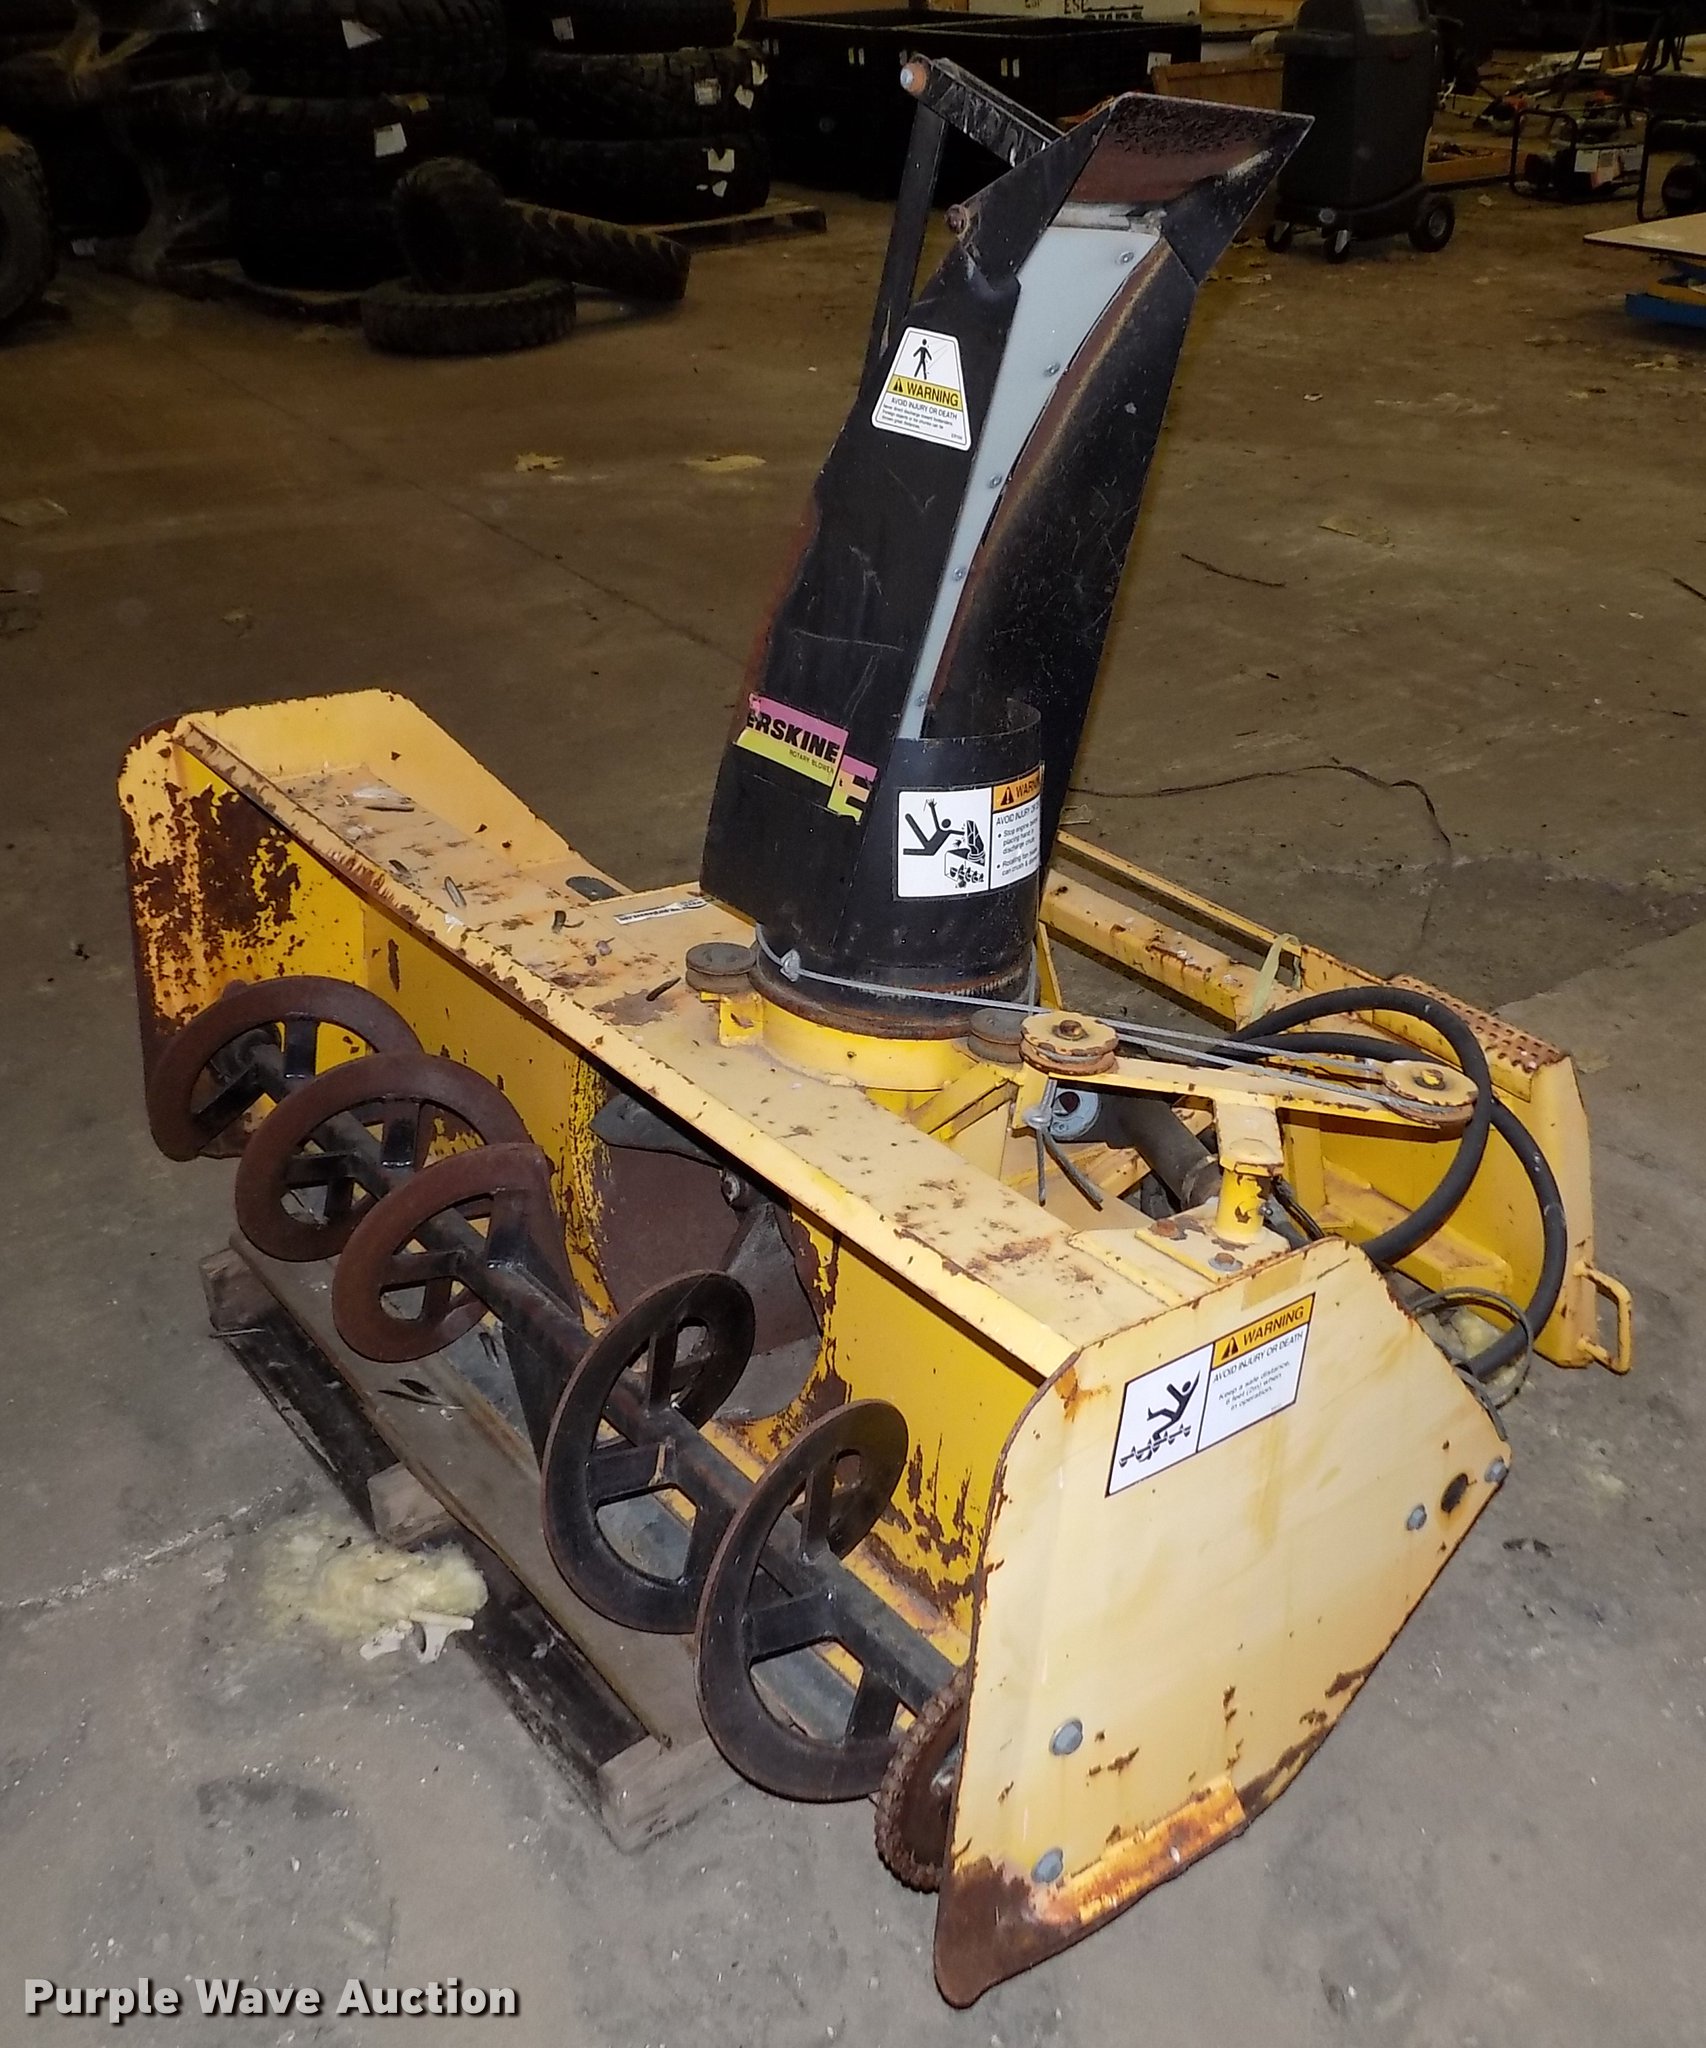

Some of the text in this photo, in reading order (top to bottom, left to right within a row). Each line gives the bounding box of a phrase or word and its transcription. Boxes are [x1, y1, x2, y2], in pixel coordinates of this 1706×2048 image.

[891, 397, 958, 420] AVOID INJURY OR DEATH
[906, 381, 959, 407] WARNING
[746, 711, 840, 763] ERSKINE
[788, 748, 835, 775] ROTARY BLOWER
[1243, 1305, 1305, 1346] WARNING
[1213, 1331, 1304, 1384] AVOID INJURY OR DEATH
